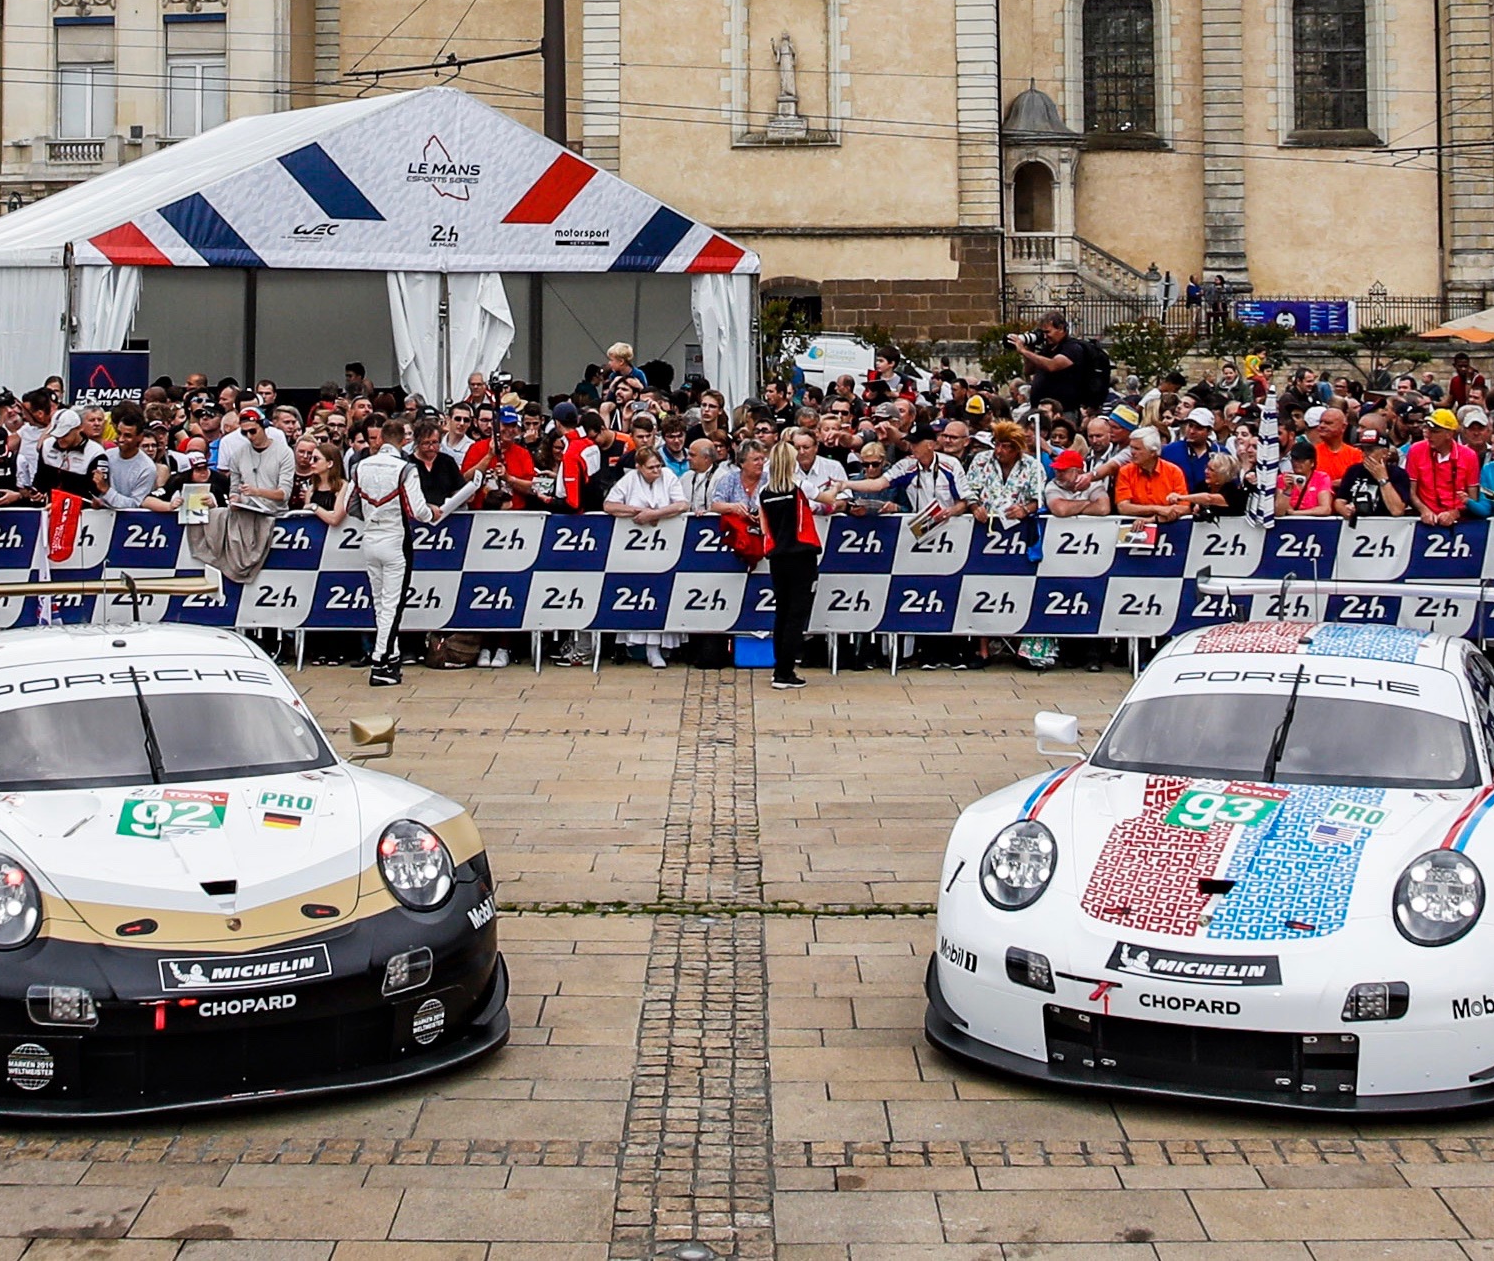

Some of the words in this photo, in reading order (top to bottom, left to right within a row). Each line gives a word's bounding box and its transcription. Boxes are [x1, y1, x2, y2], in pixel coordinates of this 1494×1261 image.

[407, 162, 428, 174] LE
[432, 162, 480, 176] MANS
[431, 225, 459, 241] 24h
[554, 228, 610, 238] motorsport
[76, 389, 98, 400] LE
[100, 388, 142, 399] MANS
[124, 525, 166, 548] 24h
[271, 527, 310, 549] 24h
[412, 527, 453, 550] 24h
[482, 528, 525, 550] 24h
[553, 527, 596, 551] 24h
[624, 529, 667, 551] 24h
[837, 530, 882, 553] 24h
[1056, 532, 1101, 555] 24h
[1203, 534, 1248, 556] 24h
[1277, 534, 1322, 558] 24h
[1353, 535, 1396, 558] 24h
[1424, 535, 1470, 558] 24h
[255, 586, 297, 608] 24h
[326, 586, 370, 609] 24h
[405, 587, 442, 608] 24h
[470, 586, 513, 609] 24h
[542, 588, 584, 609] 24h
[612, 588, 655, 611] 24h
[684, 589, 727, 611] 24h
[827, 589, 871, 612] 24h
[899, 590, 943, 613] 24h
[972, 591, 1016, 614] 24h
[1044, 592, 1089, 615] 24h
[1119, 594, 1162, 616] 24h
[1339, 596, 1385, 619] 24h
[1415, 597, 1460, 618] 24h
[1174, 671, 1421, 697] PORSCHE
[163, 791, 226, 802] TOTAL
[261, 792, 314, 810] PRO
[1230, 786, 1283, 799] TOTAL
[131, 800, 213, 836] 92
[1178, 793, 1264, 827] 93
[1329, 803, 1385, 825] PRO
[467, 899, 493, 930] Mobil
[939, 936, 965, 968] Mobil
[211, 956, 315, 980] MICHELIN
[1153, 958, 1266, 978] MICHELIN
[199, 994, 297, 1017] CHOPARD
[1139, 993, 1241, 1015] CHOPARD
[8, 1068, 54, 1076] WELTMEISTER
